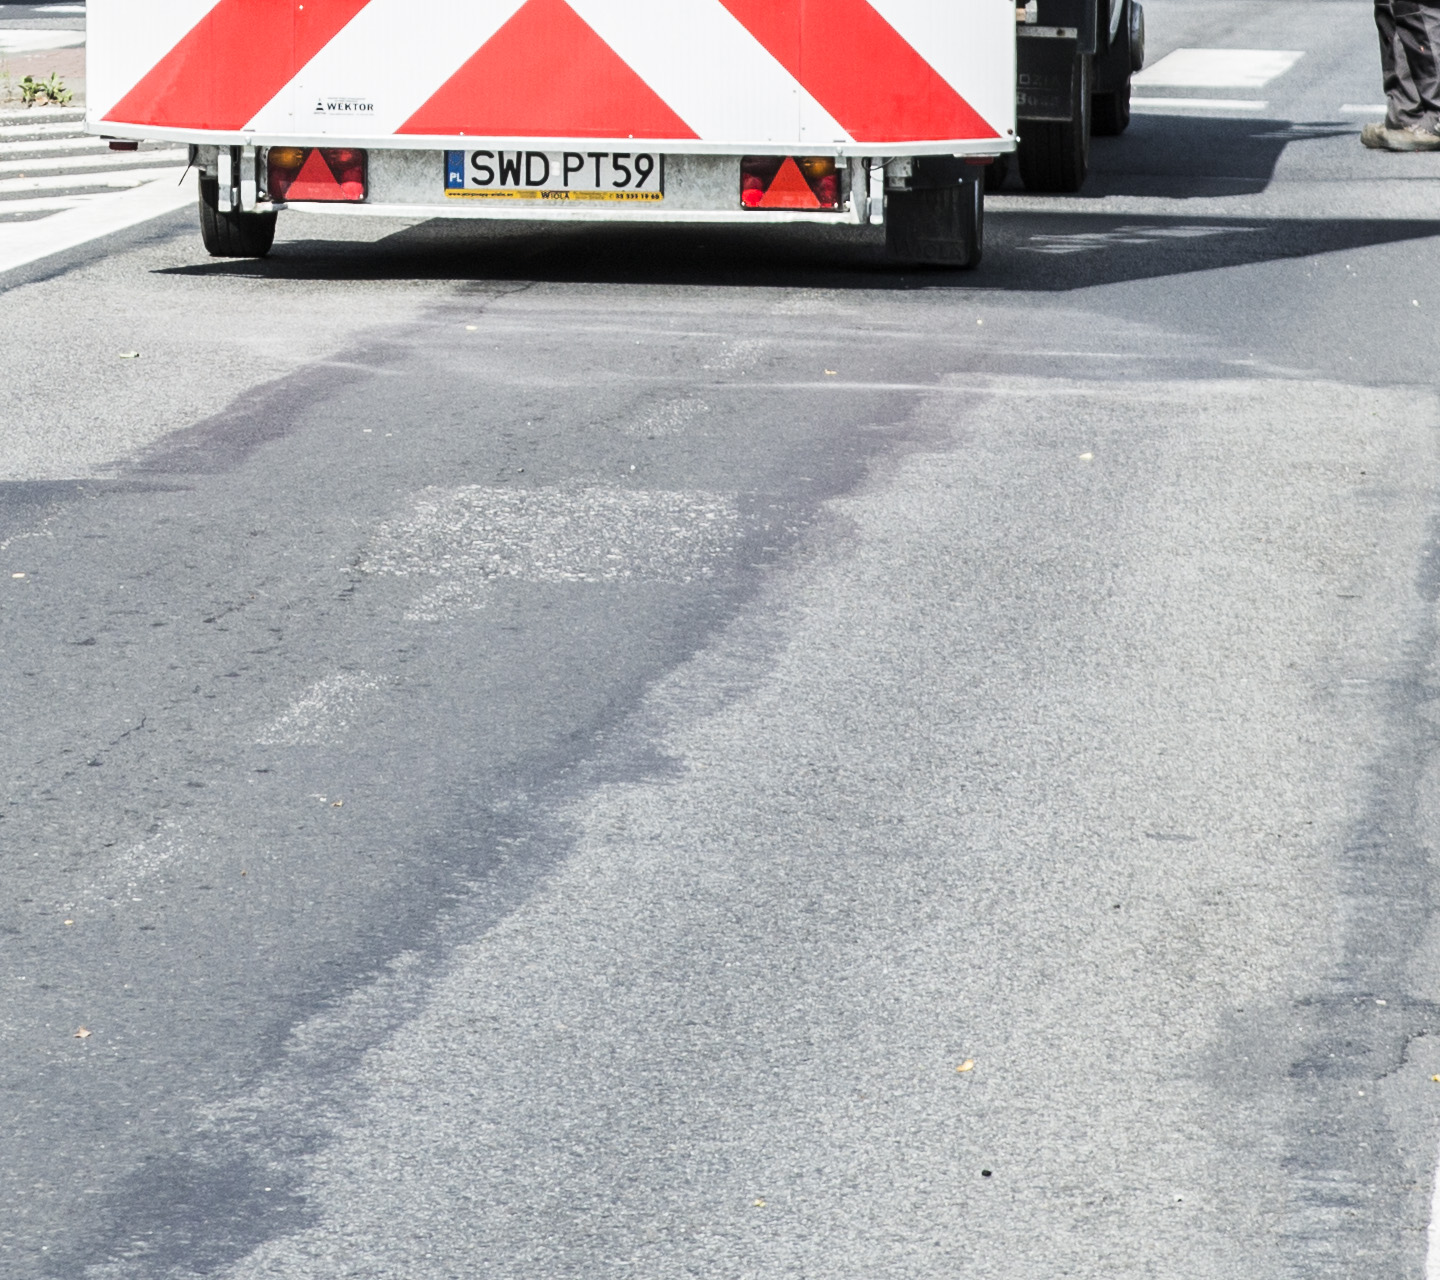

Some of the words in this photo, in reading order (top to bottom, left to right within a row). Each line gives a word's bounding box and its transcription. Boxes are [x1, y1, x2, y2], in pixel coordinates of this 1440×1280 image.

[326, 102, 374, 111] WEKTOR
[449, 172, 462, 183] PL
[470, 150, 550, 187] SWD
[563, 151, 654, 188] PT59
